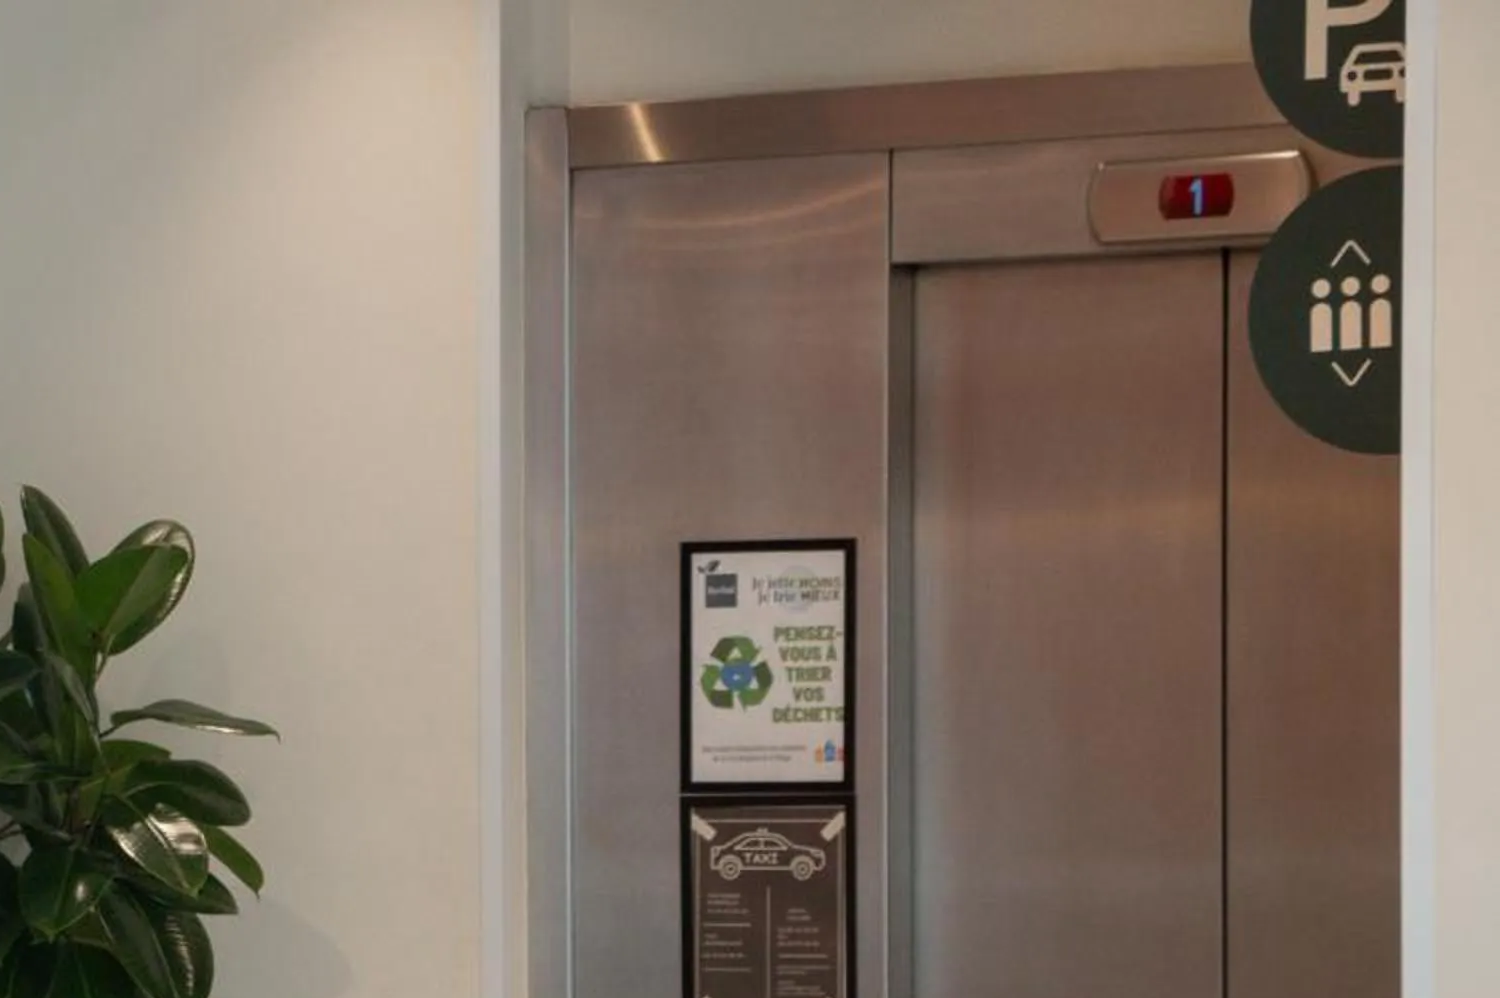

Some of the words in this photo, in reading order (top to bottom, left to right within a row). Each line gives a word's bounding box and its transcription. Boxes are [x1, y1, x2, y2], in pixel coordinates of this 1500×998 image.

[1304, 0, 1393, 80] P
[1189, 178, 1204, 216] 1
[778, 645, 822, 662] VOUS
[785, 666, 833, 683] TRIER
[793, 687, 825, 702] VOS
[772, 703, 845, 723] DÉCHETS
[742, 851, 779, 865] TAXI
